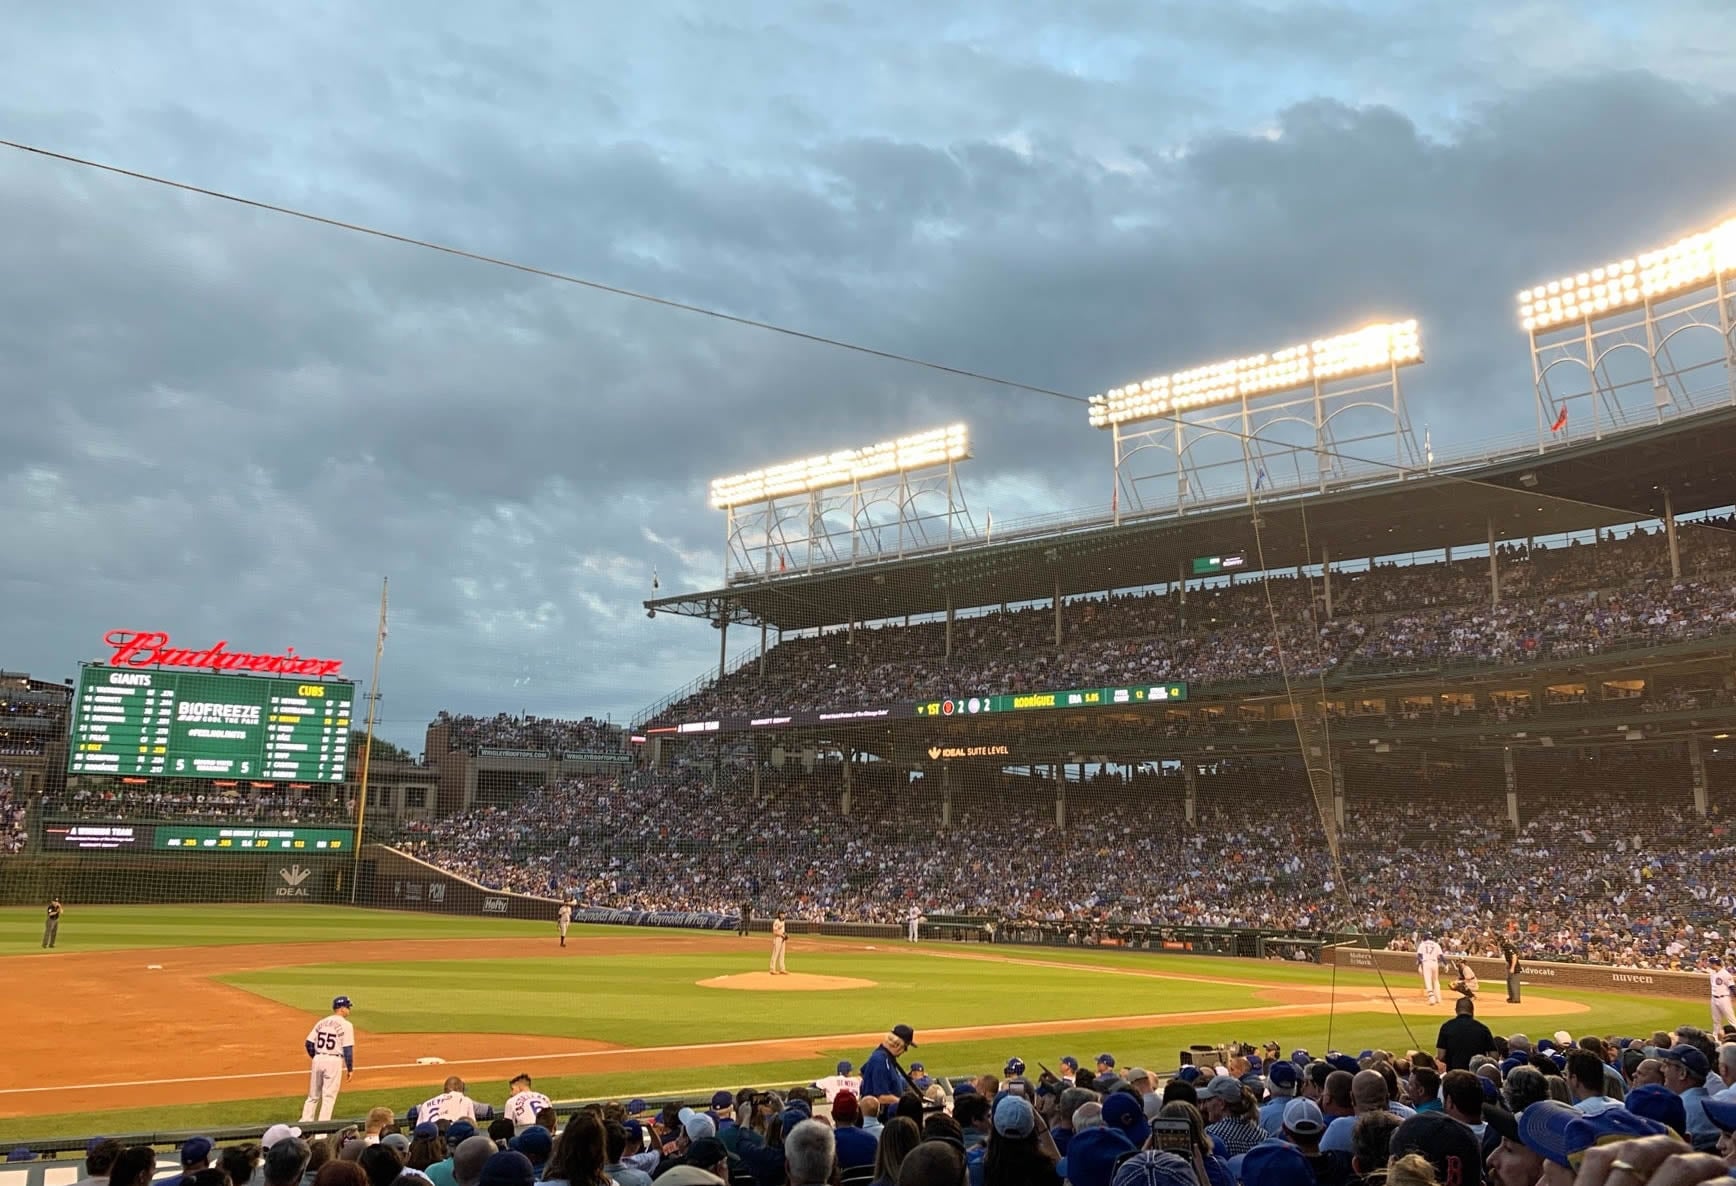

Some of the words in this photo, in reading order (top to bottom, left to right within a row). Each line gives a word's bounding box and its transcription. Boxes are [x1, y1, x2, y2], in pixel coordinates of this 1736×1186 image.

[104, 629, 343, 676] Budweiser
[110, 673, 151, 686] GIANTS
[298, 685, 324, 697] CUBS
[928, 704, 940, 715] 1ST
[958, 700, 964, 713] 2
[984, 698, 990, 711] 2
[1014, 694, 1055, 708] RODRÍGUEZ
[178, 702, 262, 718] BIOFREEZE
[942, 749, 966, 757] IDEAL
[967, 747, 986, 756] SUITE
[988, 746, 1008, 755] LEVEL
[176, 759, 184, 770] 5
[241, 762, 249, 773] 5
[485, 900, 506, 910] Hefty
[574, 909, 608, 921] Reynolds
[608, 910, 630, 922] Wrap
[648, 912, 684, 924] Reynolds
[684, 913, 708, 926] Wrap
[1425, 946, 1434, 954] 17
[1521, 967, 1555, 976] Advocate
[1612, 973, 1653, 984] nuveen
[317, 1032, 337, 1050] 55
[1447, 1155, 1462, 1186] B
